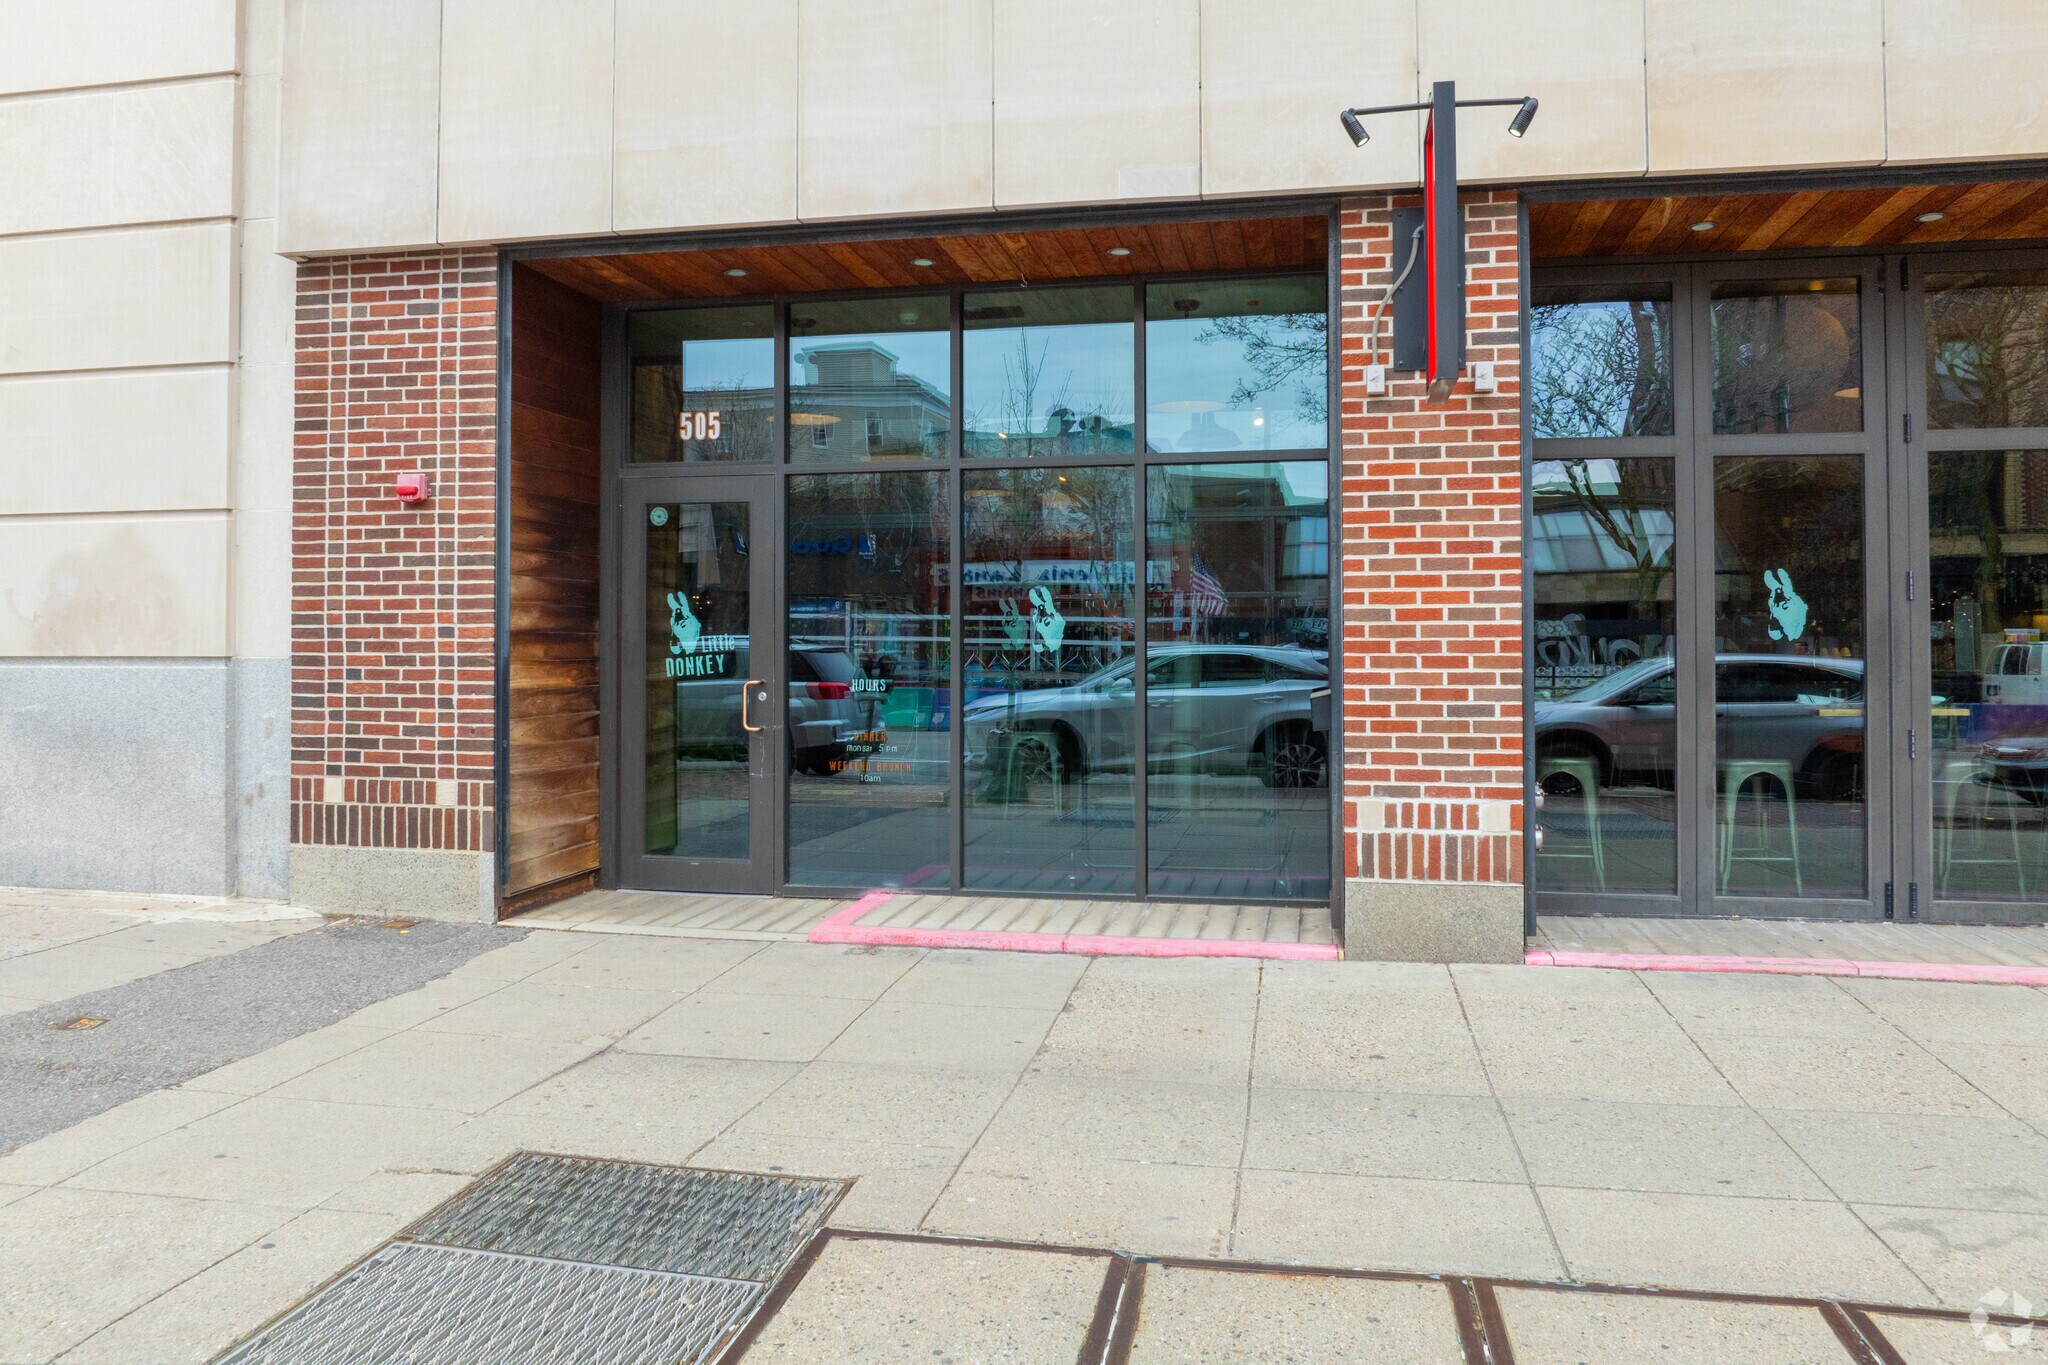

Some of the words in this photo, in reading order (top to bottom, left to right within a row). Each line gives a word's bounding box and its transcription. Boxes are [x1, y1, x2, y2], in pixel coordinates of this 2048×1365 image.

[679, 411, 721, 440] 505
[665, 654, 725, 677] DONKEY
[851, 678, 887, 692] HOURS
[853, 731, 888, 742] DINNER
[829, 760, 871, 772] WEEKEND
[860, 774, 881, 782] 10am
